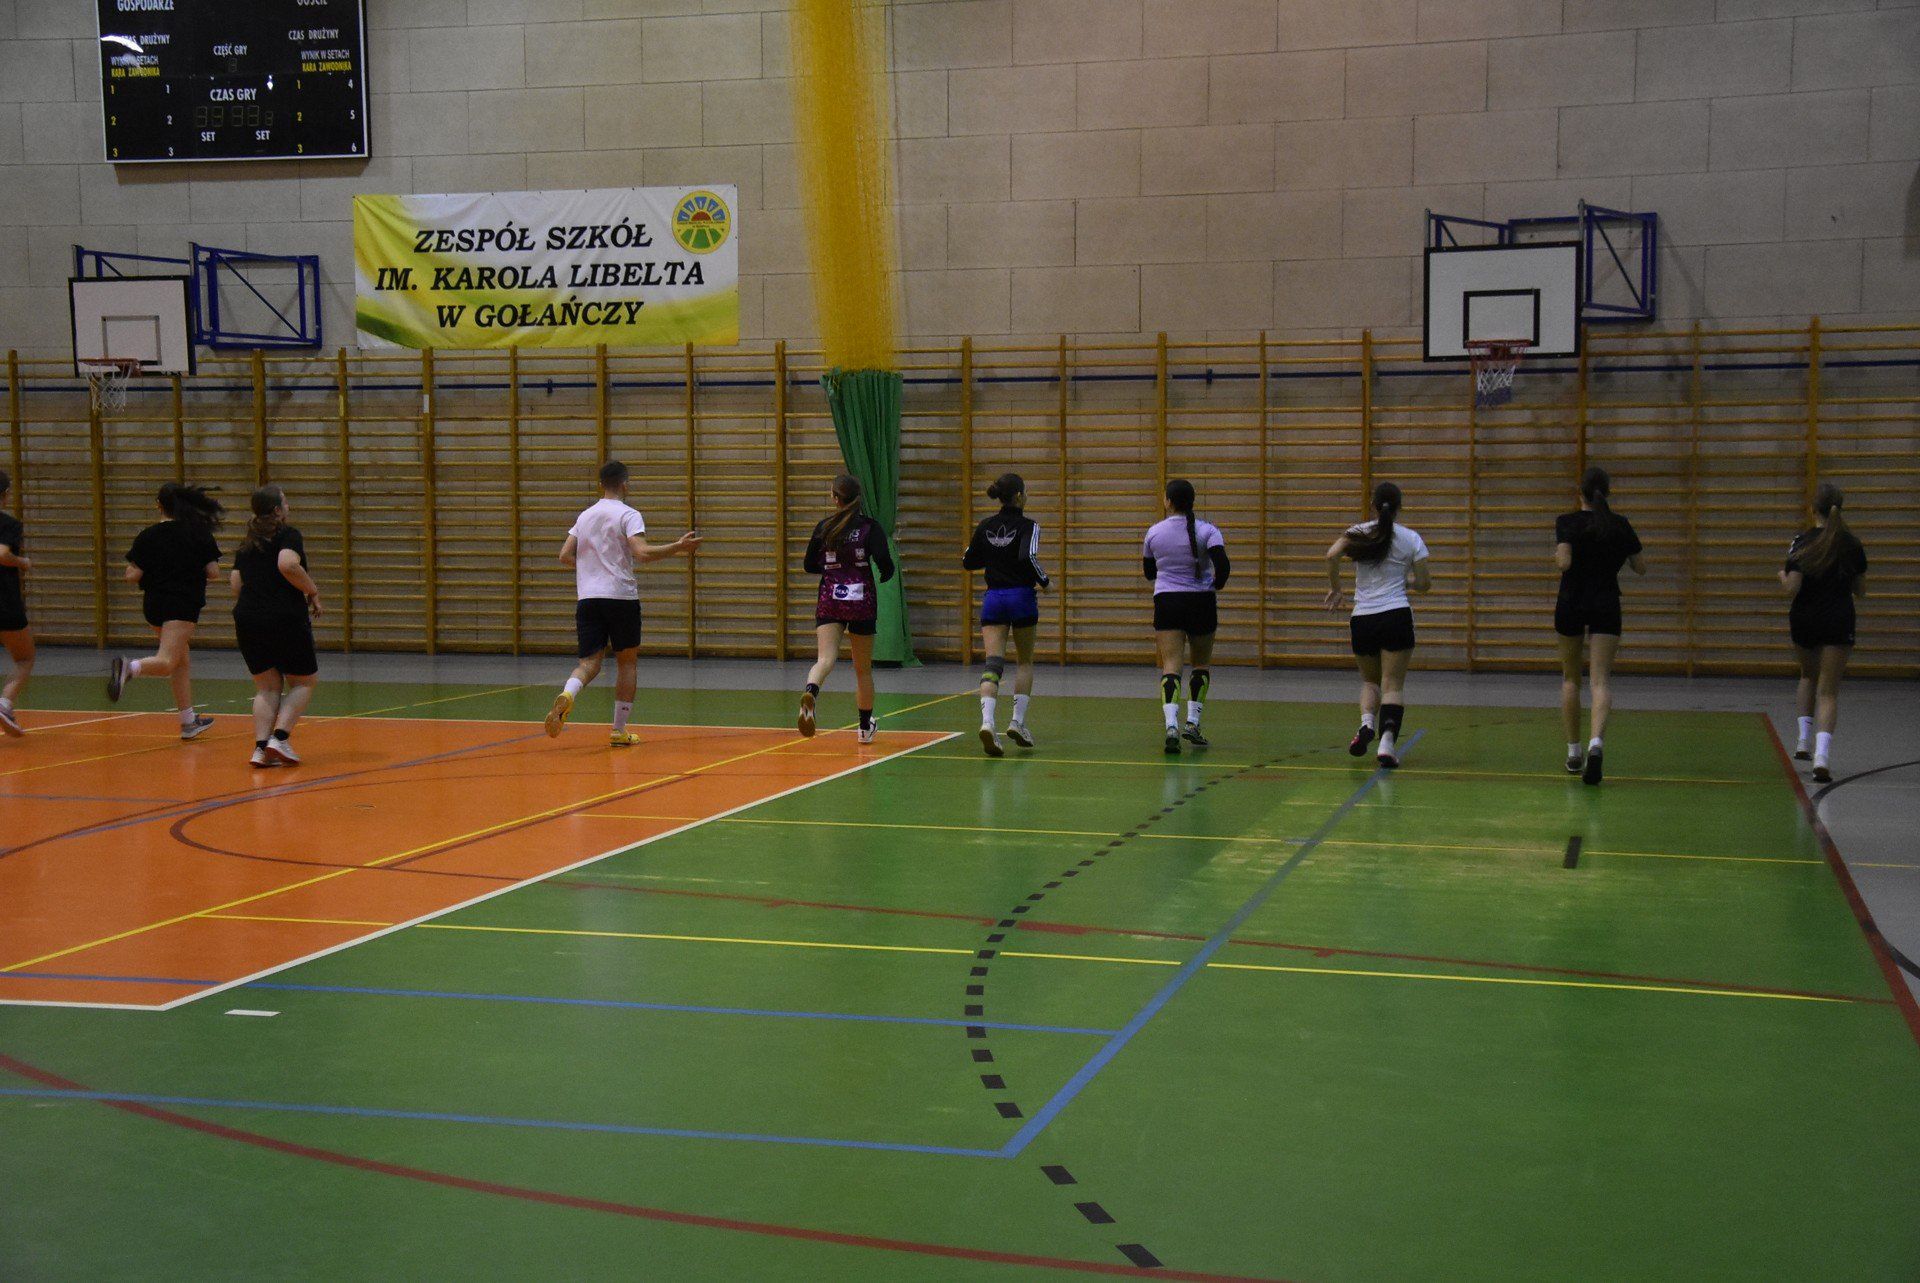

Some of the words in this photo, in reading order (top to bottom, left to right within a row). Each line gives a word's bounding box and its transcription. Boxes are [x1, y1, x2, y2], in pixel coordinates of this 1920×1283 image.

[117, 0, 175, 12] GOSPODARZE
[139, 32, 171, 45] DRUŻYNY
[288, 30, 305, 41] CZAS
[308, 27, 340, 40] DRUŻYNY
[213, 43, 233, 58] CZĘŚĆ
[234, 45, 248, 56] GRY
[301, 50, 320, 61] WYNIK
[320, 50, 328, 60] W
[328, 49, 351, 60] SETACH
[302, 62, 317, 73] KARA
[165, 84, 170, 94] 1
[296, 79, 301, 90] 1
[347, 78, 354, 89] 4
[110, 84, 115, 95] 1
[210, 88, 235, 102] CZAS
[236, 88, 258, 101] GRY
[166, 114, 173, 126] 2
[296, 111, 303, 122] 2
[350, 109, 356, 120] 5
[110, 115, 117, 126] 2
[201, 131, 216, 142] SET
[255, 130, 271, 141] SET
[112, 147, 119, 158] 3
[168, 146, 174, 157] 3
[296, 143, 303, 154] 3
[351, 142, 357, 153] 6
[413, 221, 536, 253] ZESPÓŁ
[545, 217, 654, 250] SZKÓŁ
[374, 267, 418, 291] IM.
[430, 265, 558, 291] KAROLA
[567, 261, 705, 288] LIBELTA
[436, 305, 466, 328] W
[474, 296, 645, 327] GOŁAŃCZY
